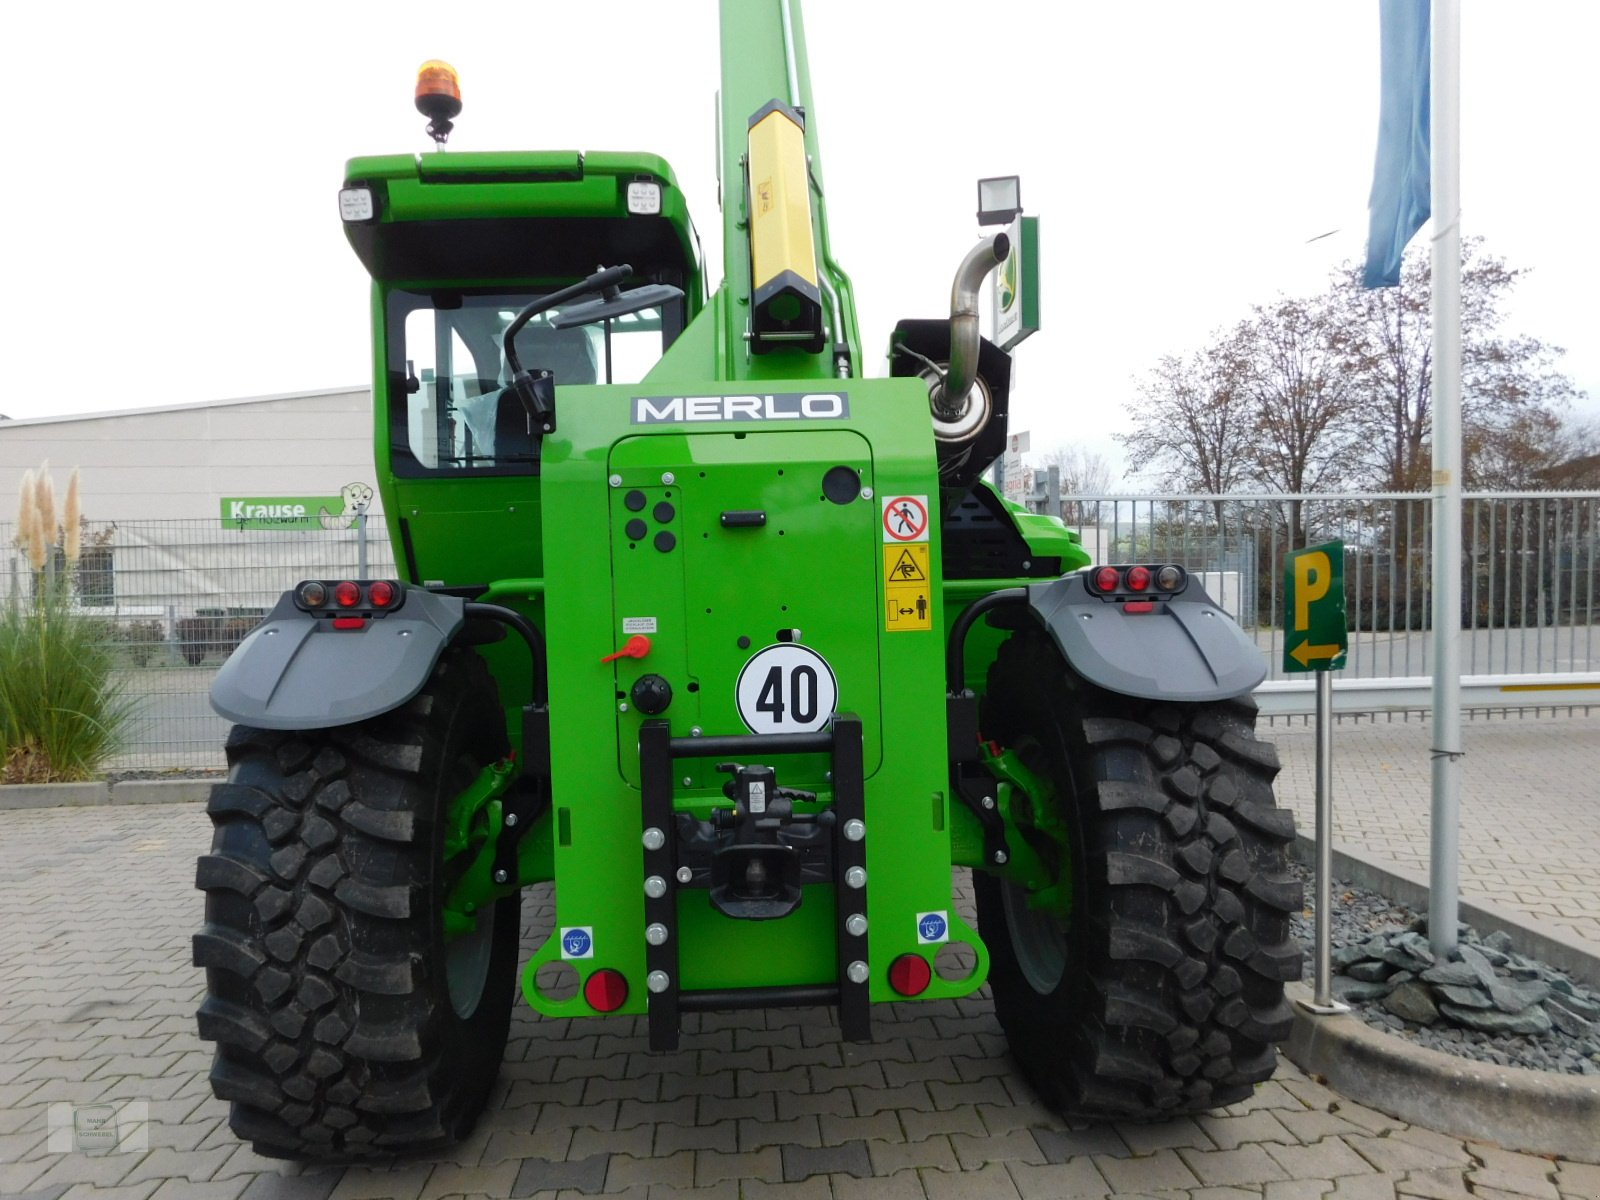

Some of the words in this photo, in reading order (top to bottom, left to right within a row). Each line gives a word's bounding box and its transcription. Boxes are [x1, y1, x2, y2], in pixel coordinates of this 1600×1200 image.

[637, 394, 843, 422] MERLO
[230, 501, 305, 518] Krause
[1295, 551, 1331, 631] P
[755, 664, 818, 724] 40
